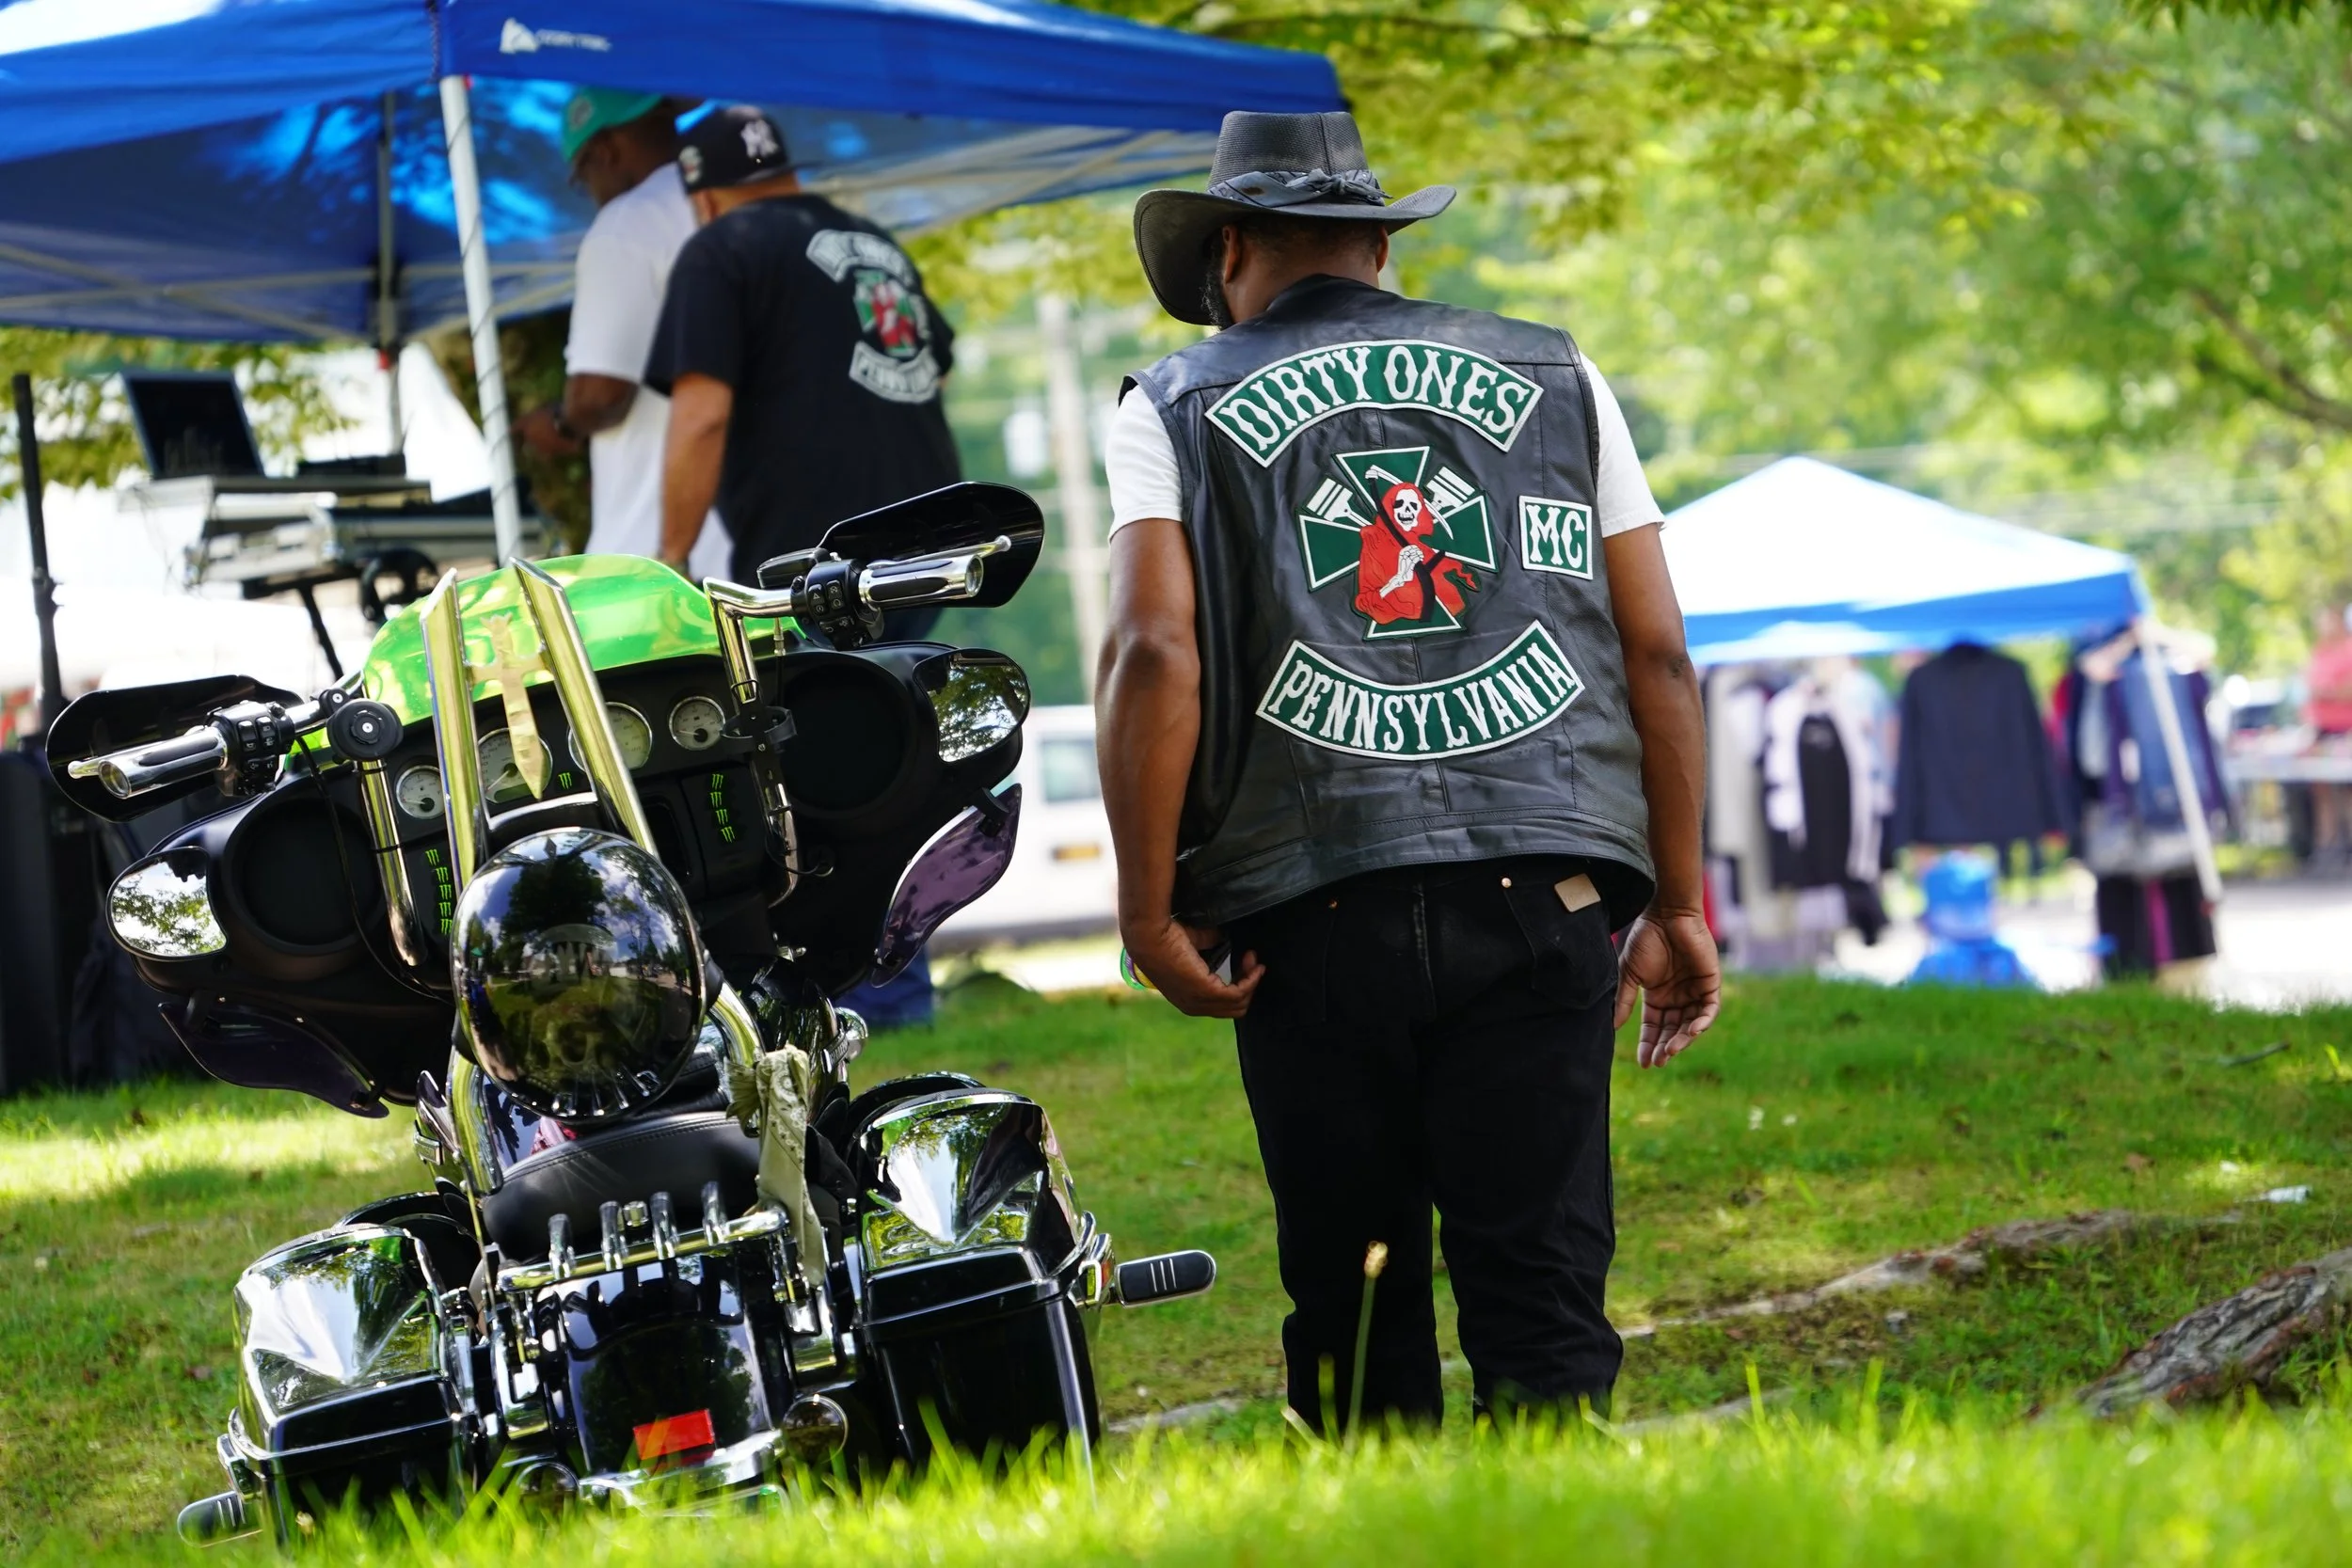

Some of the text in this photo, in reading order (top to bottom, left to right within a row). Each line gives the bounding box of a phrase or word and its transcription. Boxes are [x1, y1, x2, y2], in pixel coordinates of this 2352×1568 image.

[1219, 345, 1530, 451] DIRTY ONES
[1525, 504, 1586, 569] MC
[1267, 641, 1577, 752] PENNSYLVANIA
